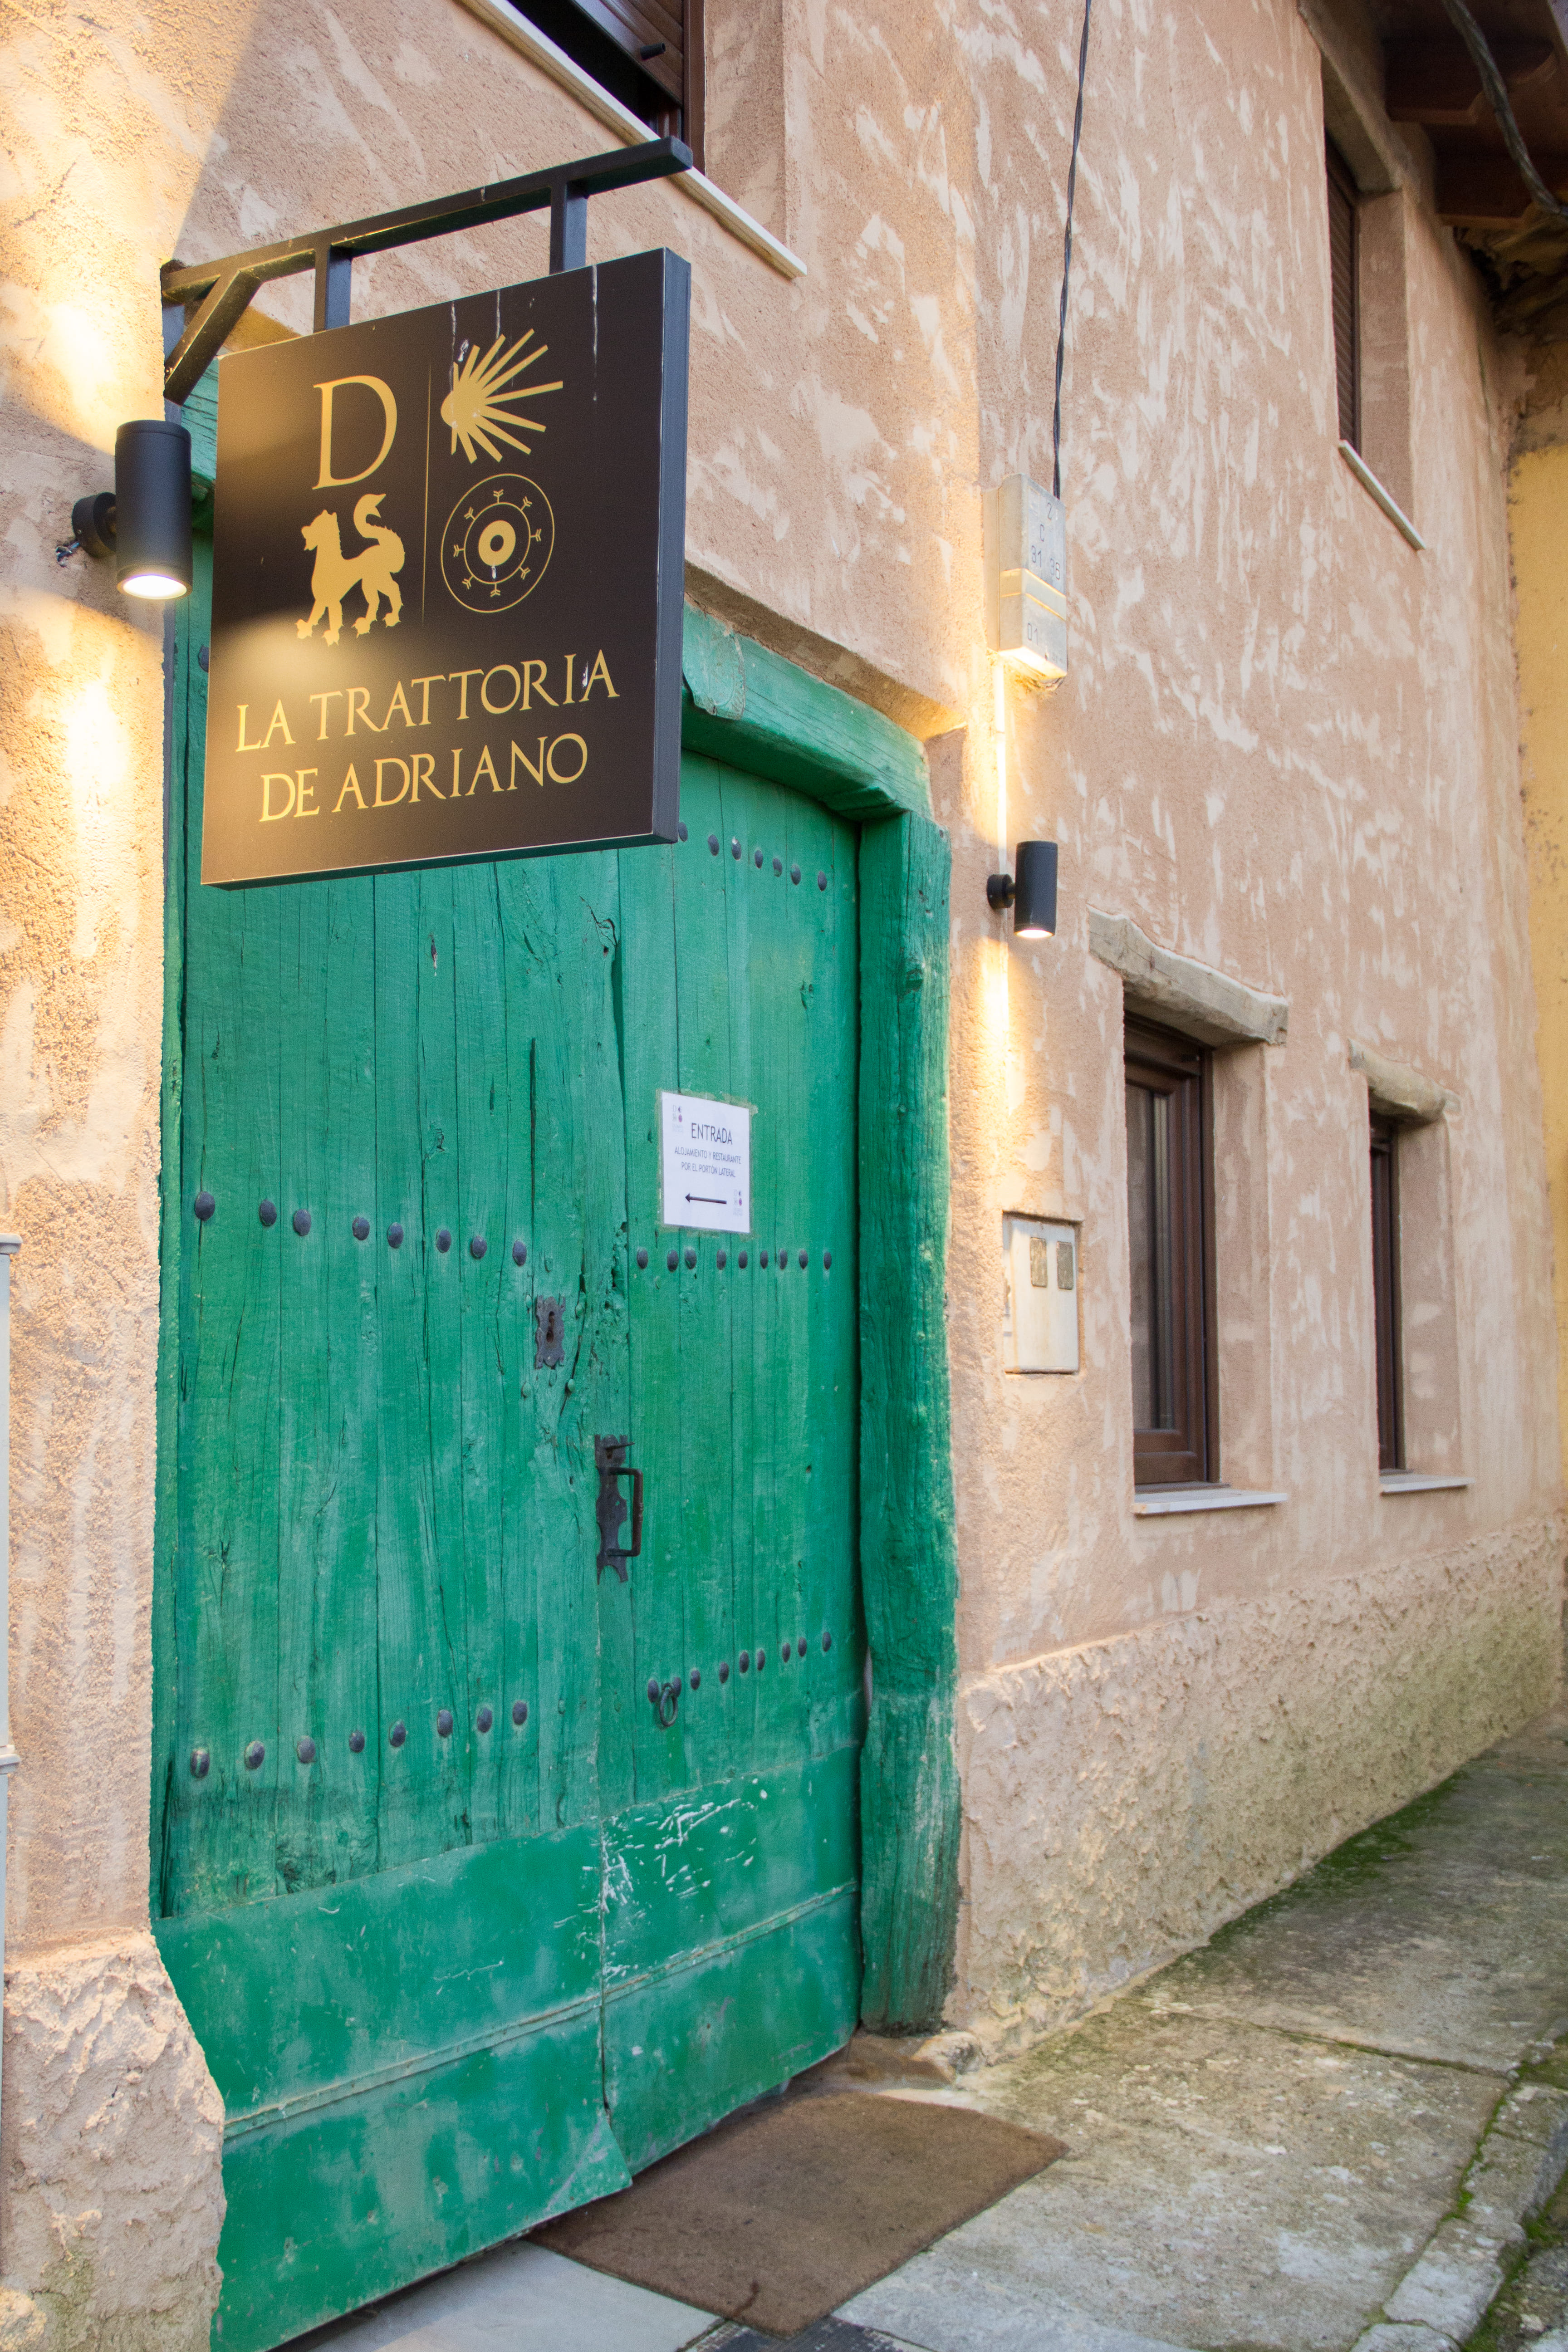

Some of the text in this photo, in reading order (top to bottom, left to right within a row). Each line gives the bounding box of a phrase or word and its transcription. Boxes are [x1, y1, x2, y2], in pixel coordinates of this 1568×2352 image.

[312, 375, 397, 490] D
[1047, 502, 1052, 521] 2
[1039, 523, 1045, 542] C
[235, 649, 620, 752] LA TRATTORIA
[259, 733, 588, 823] DE ADRIANO
[691, 1122, 733, 1145] ENTRADA
[674, 1146, 741, 1165] ALOJAMIENTO Y RESTAURANTE
[681, 1161, 736, 1178] POR EL PORTÓN LATERAL
